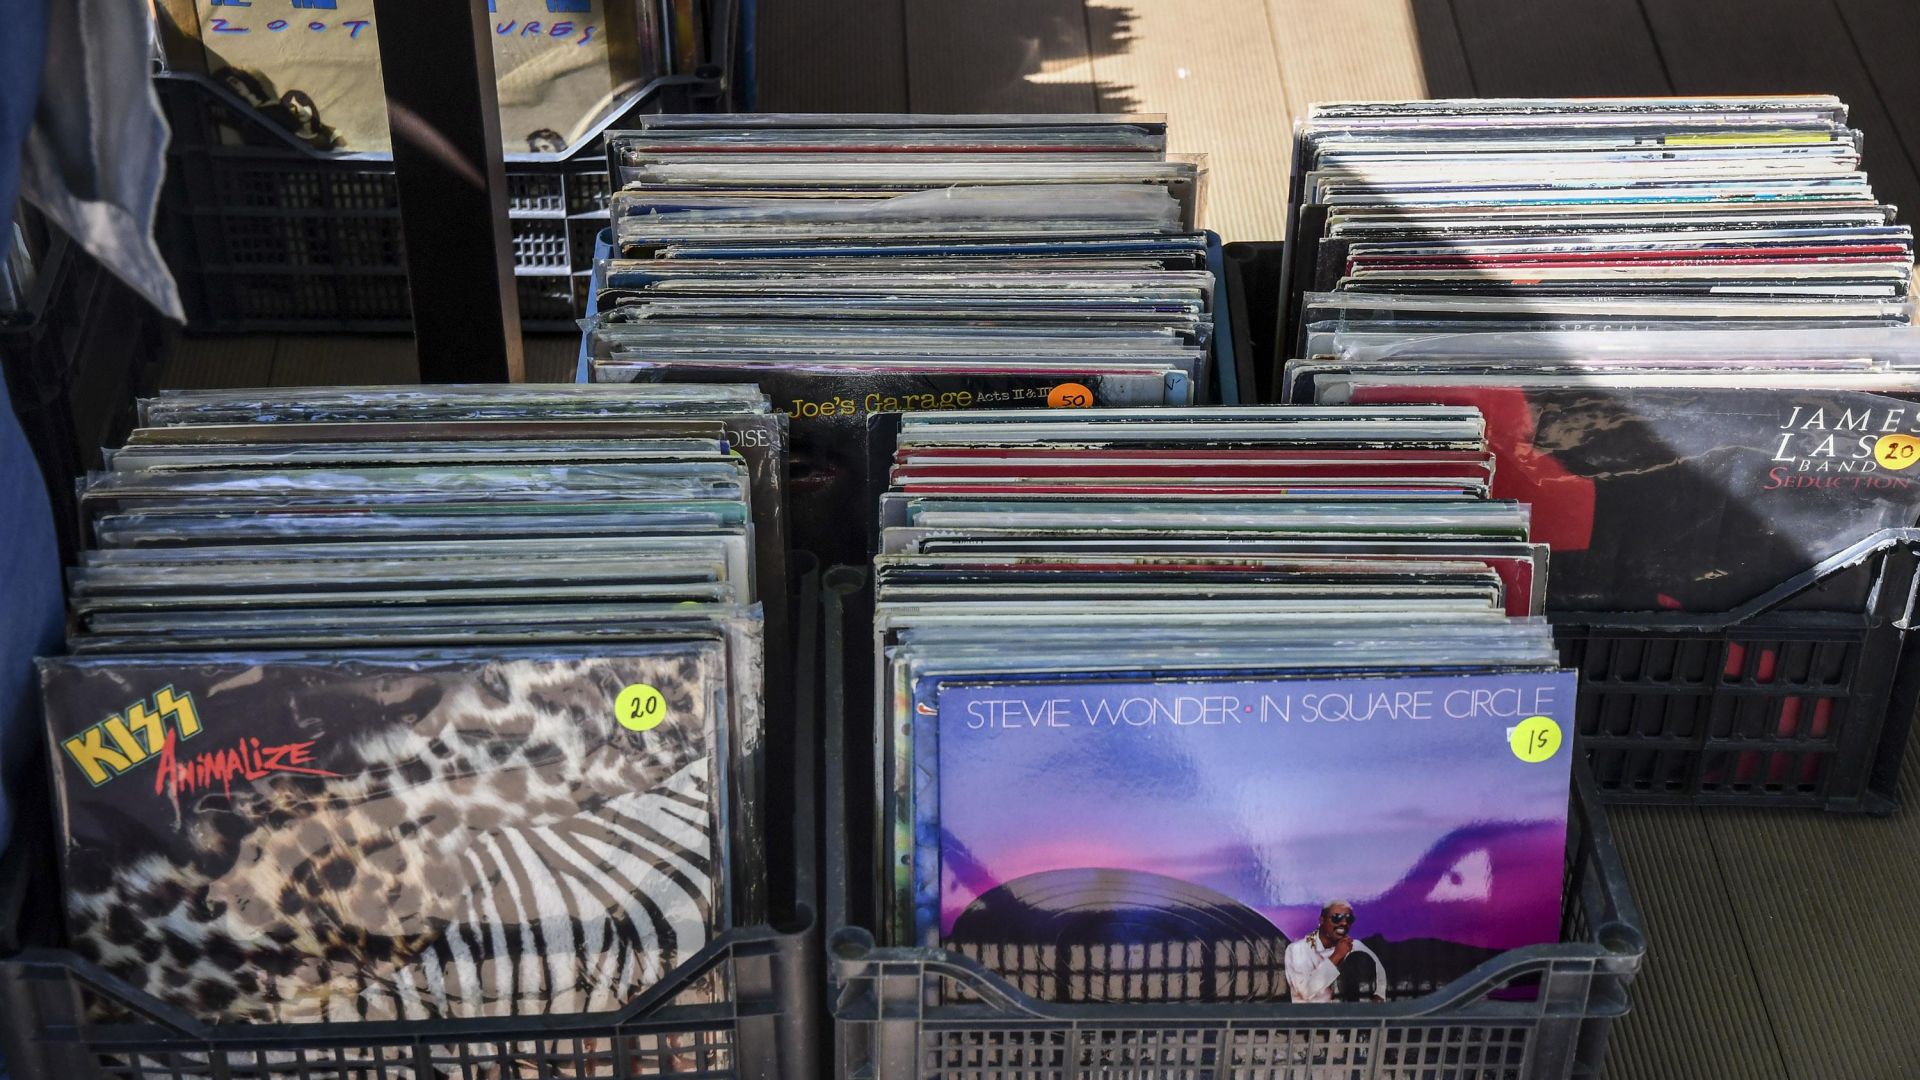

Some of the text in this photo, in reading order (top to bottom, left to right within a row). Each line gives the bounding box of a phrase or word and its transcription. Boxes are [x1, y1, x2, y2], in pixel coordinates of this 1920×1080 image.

[209, 18, 600, 46] ZOOT URES
[787, 396, 856, 418] Joe's
[864, 390, 972, 413] Garage
[977, 390, 1010, 402] Acts
[1061, 394, 1086, 407] 50
[1771, 432, 1879, 463] LAS
[1884, 442, 1914, 460] 20
[1763, 466, 1909, 490] SEDUCTION
[1798, 459, 1877, 473] BAND
[631, 695, 657, 719] 20
[966, 686, 1556, 729] STEVIE WONDER IN SQUARE CIRCLE
[60, 683, 203, 788] KISS
[1528, 729, 1549, 755] 15
